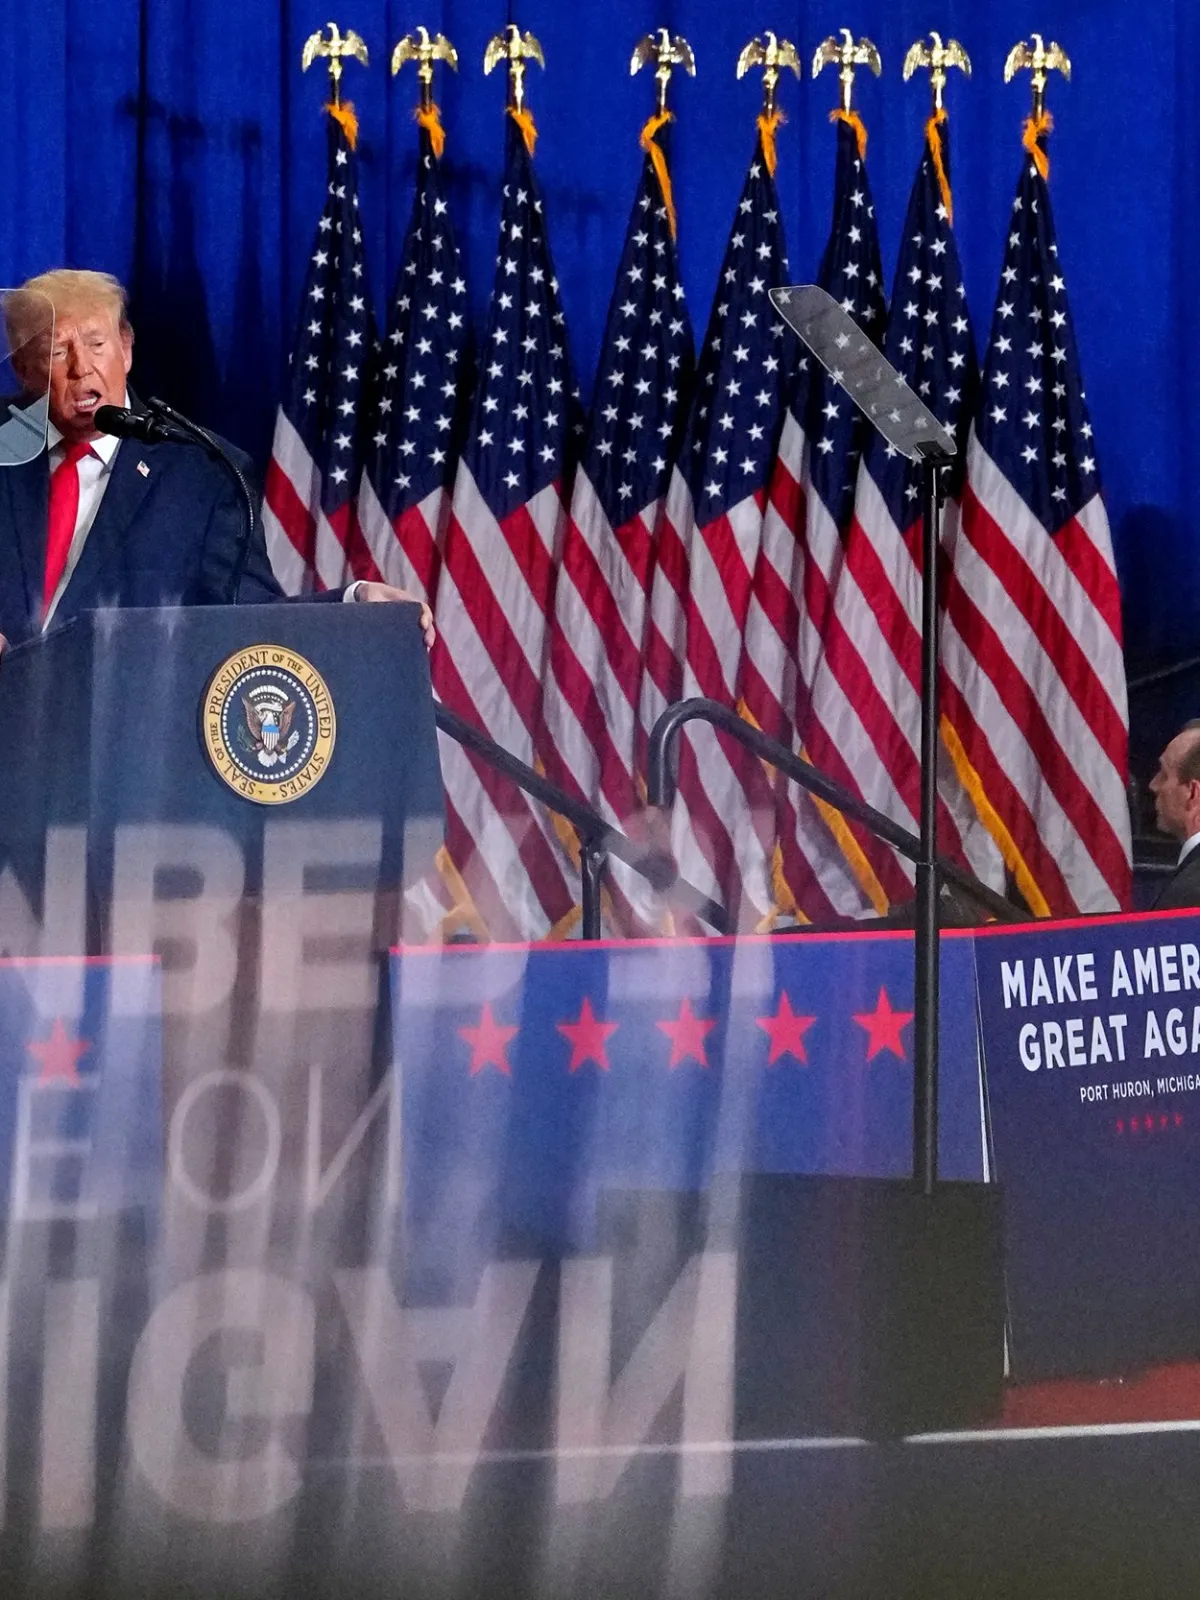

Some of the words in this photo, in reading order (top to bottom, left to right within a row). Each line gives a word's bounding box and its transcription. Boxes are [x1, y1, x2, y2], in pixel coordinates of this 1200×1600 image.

[272, 654, 285, 665] OF
[286, 657, 304, 674] THE
[209, 651, 269, 717] PRESIDENT
[305, 673, 331, 739] UNITED
[211, 722, 220, 744] THE
[213, 747, 225, 761] OF
[221, 760, 257, 796] SEAL
[279, 752, 325, 798] STATES
[1001, 952, 1098, 1009] MAKE
[1111, 942, 1200, 998] AMER
[1019, 1013, 1128, 1071] GREAT
[1079, 1084, 1109, 1103] PORT
[1112, 1078, 1155, 1099] HURON,
